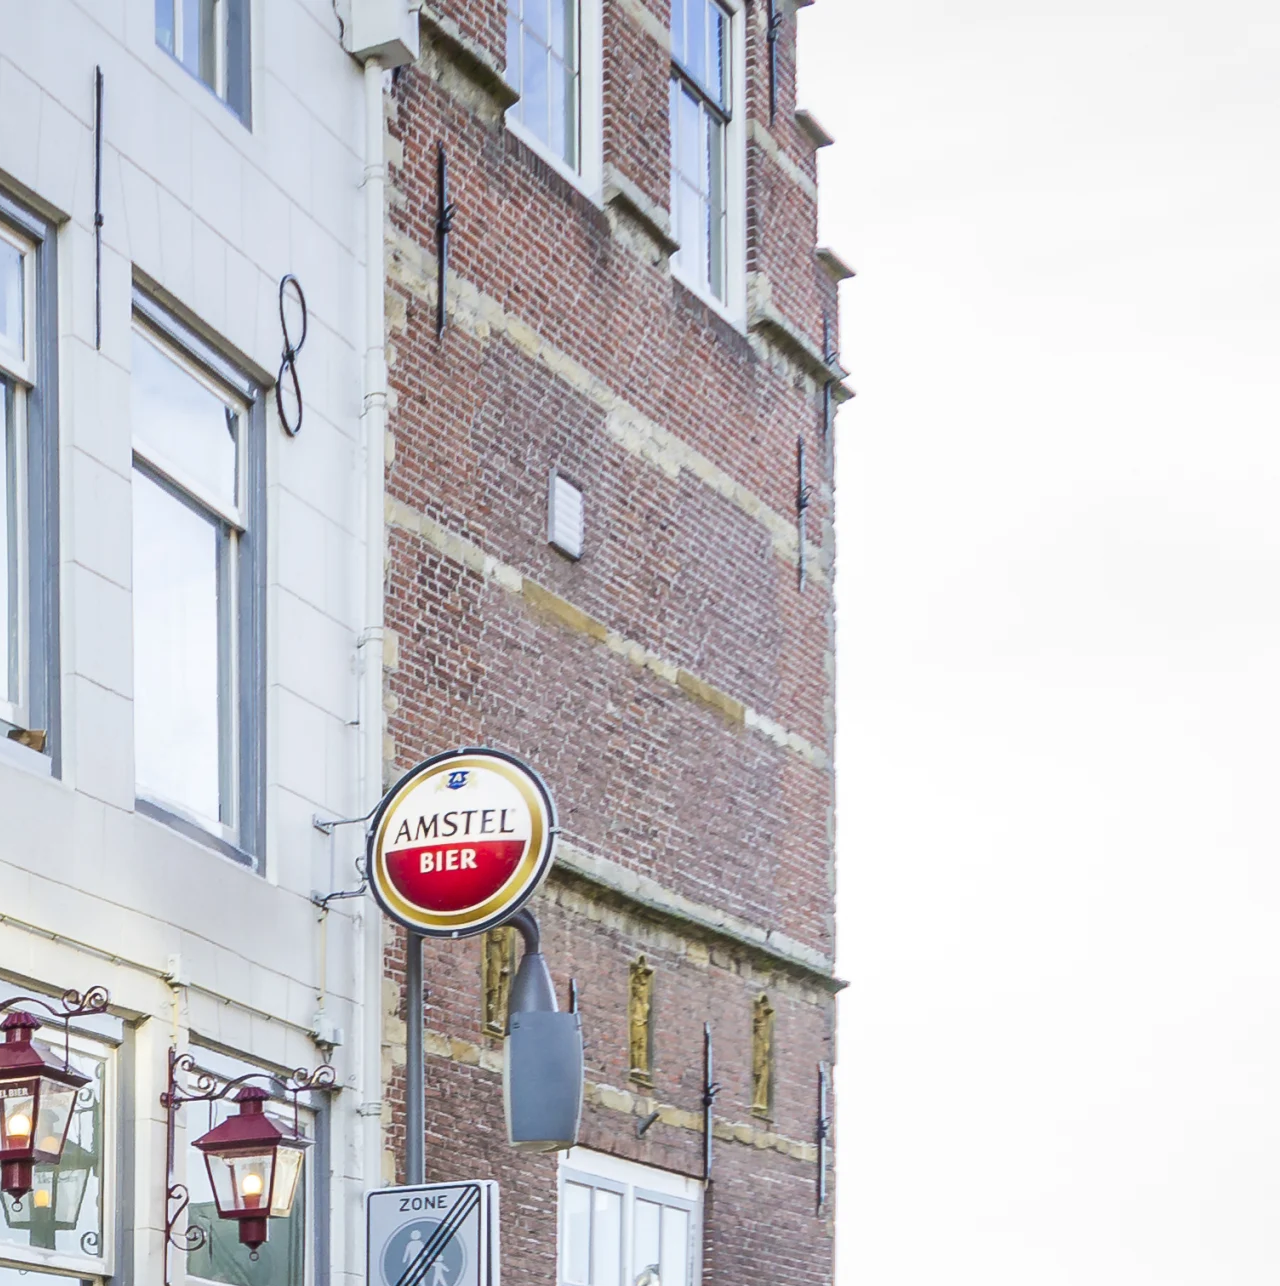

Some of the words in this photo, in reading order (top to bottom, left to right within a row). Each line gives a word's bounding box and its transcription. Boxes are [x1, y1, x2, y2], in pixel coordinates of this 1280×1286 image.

[393, 809, 515, 845] AMSTEL
[419, 848, 478, 873] BIER
[399, 1195, 448, 1212] ZONE
